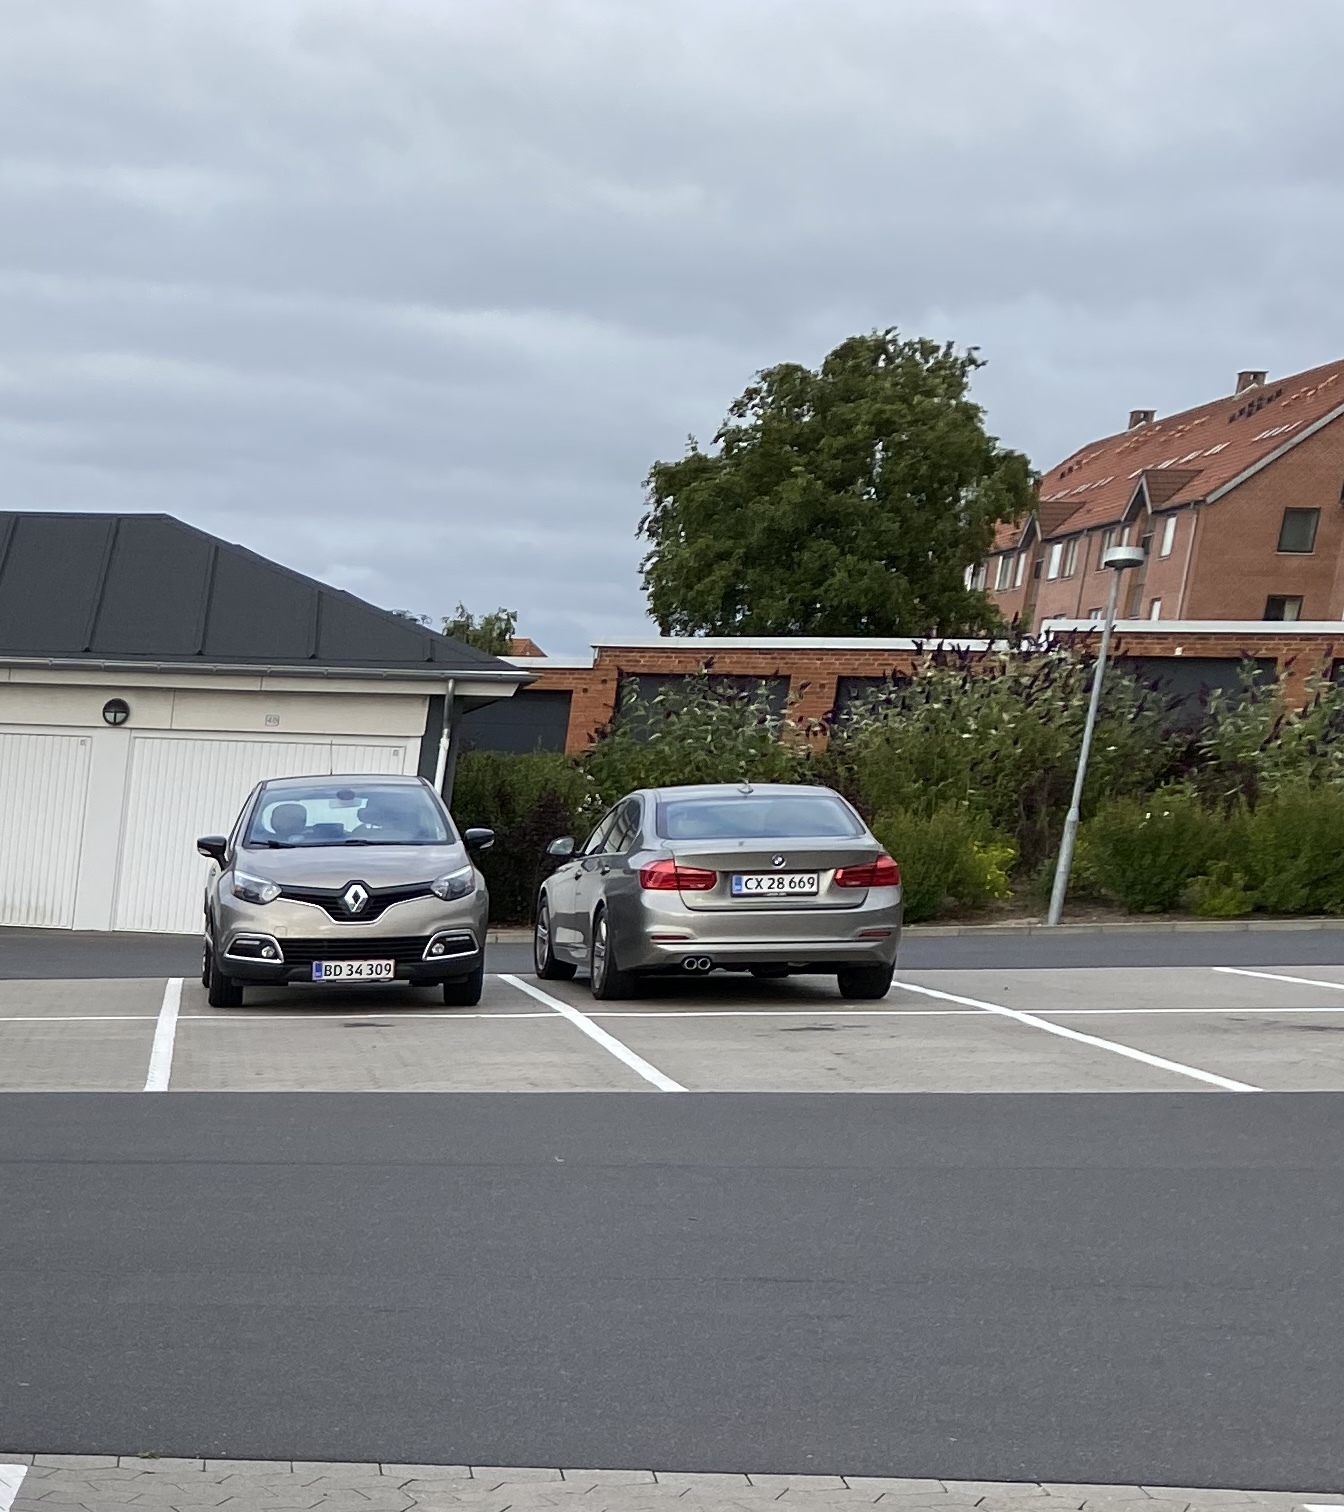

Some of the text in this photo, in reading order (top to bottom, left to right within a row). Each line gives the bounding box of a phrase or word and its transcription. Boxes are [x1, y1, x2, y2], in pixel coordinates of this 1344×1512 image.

[744, 876, 815, 890] CX 28 669
[324, 962, 392, 977] BD 34 309
